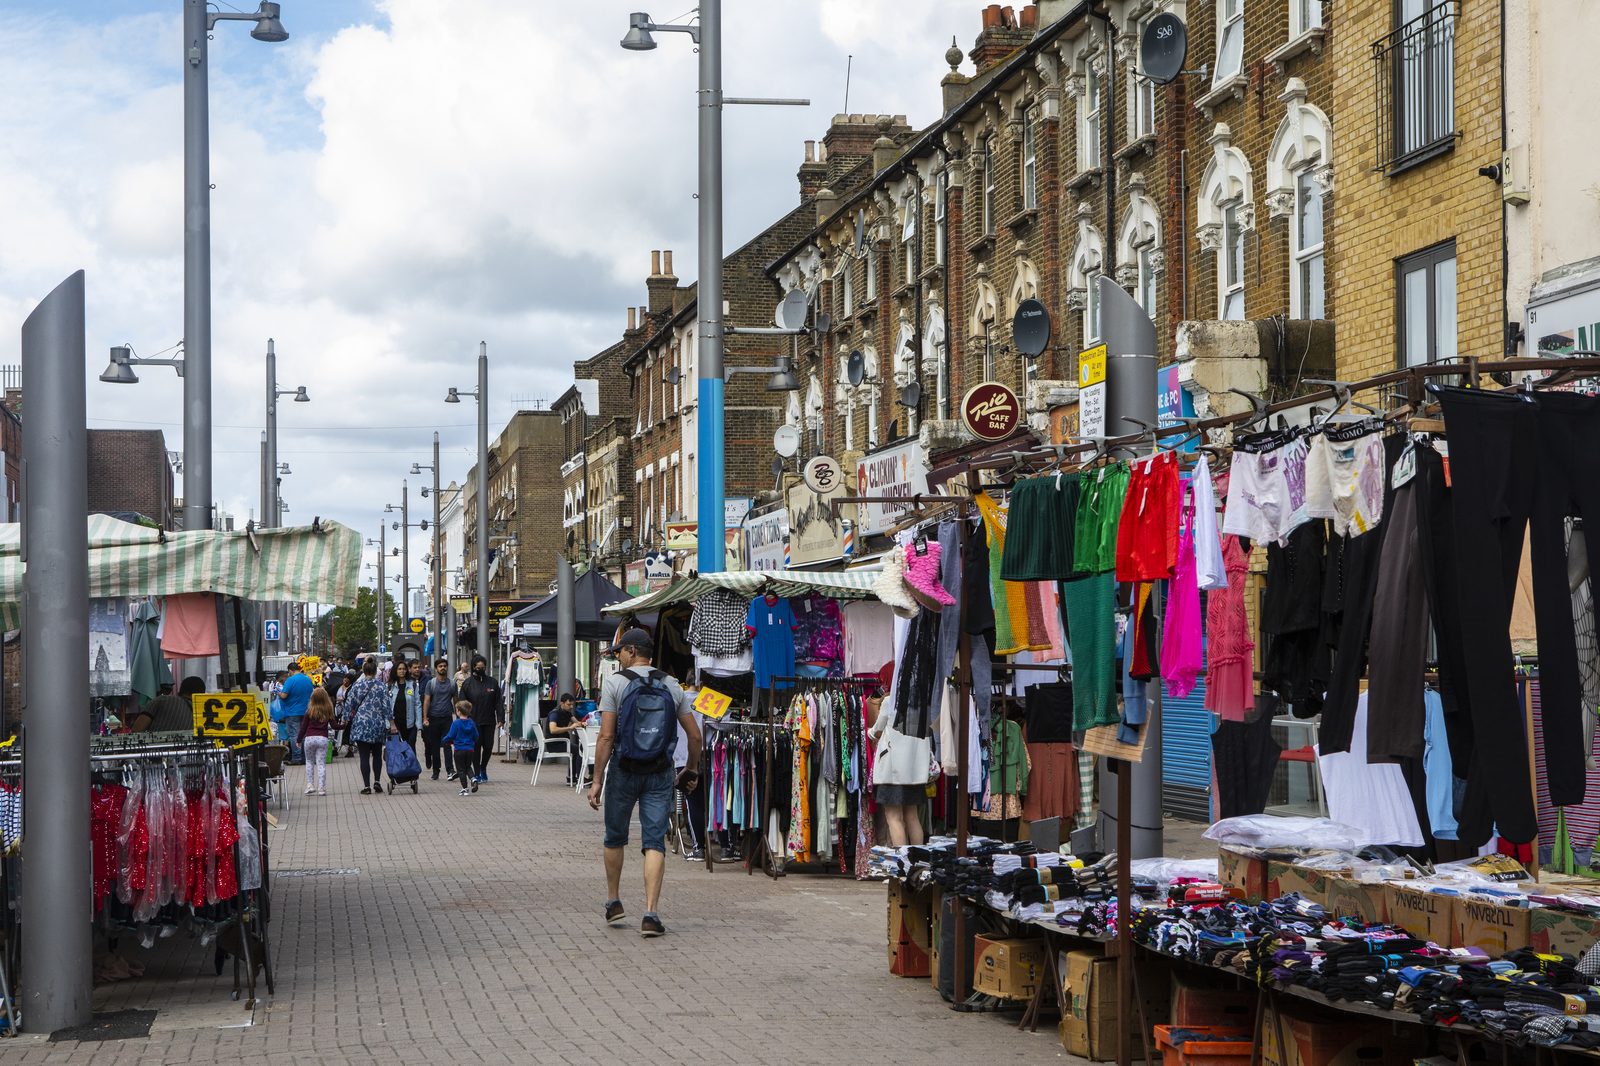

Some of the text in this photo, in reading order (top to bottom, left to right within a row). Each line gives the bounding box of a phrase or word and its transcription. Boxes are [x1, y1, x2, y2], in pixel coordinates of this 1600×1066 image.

[1530, 311, 1537, 324] 91
[1080, 348, 1105, 362] Pedestrian Zone
[1169, 390, 1179, 406] PC
[969, 392, 1012, 422] Rio
[988, 421, 1006, 430] BAR
[989, 413, 1010, 423] CAFE
[1337, 427, 1364, 441] UOMO
[698, 692, 726, 715] £1
[202, 698, 249, 731] £2
[1395, 891, 1438, 914] TURBANA
[1465, 901, 1514, 927] TURBANA
